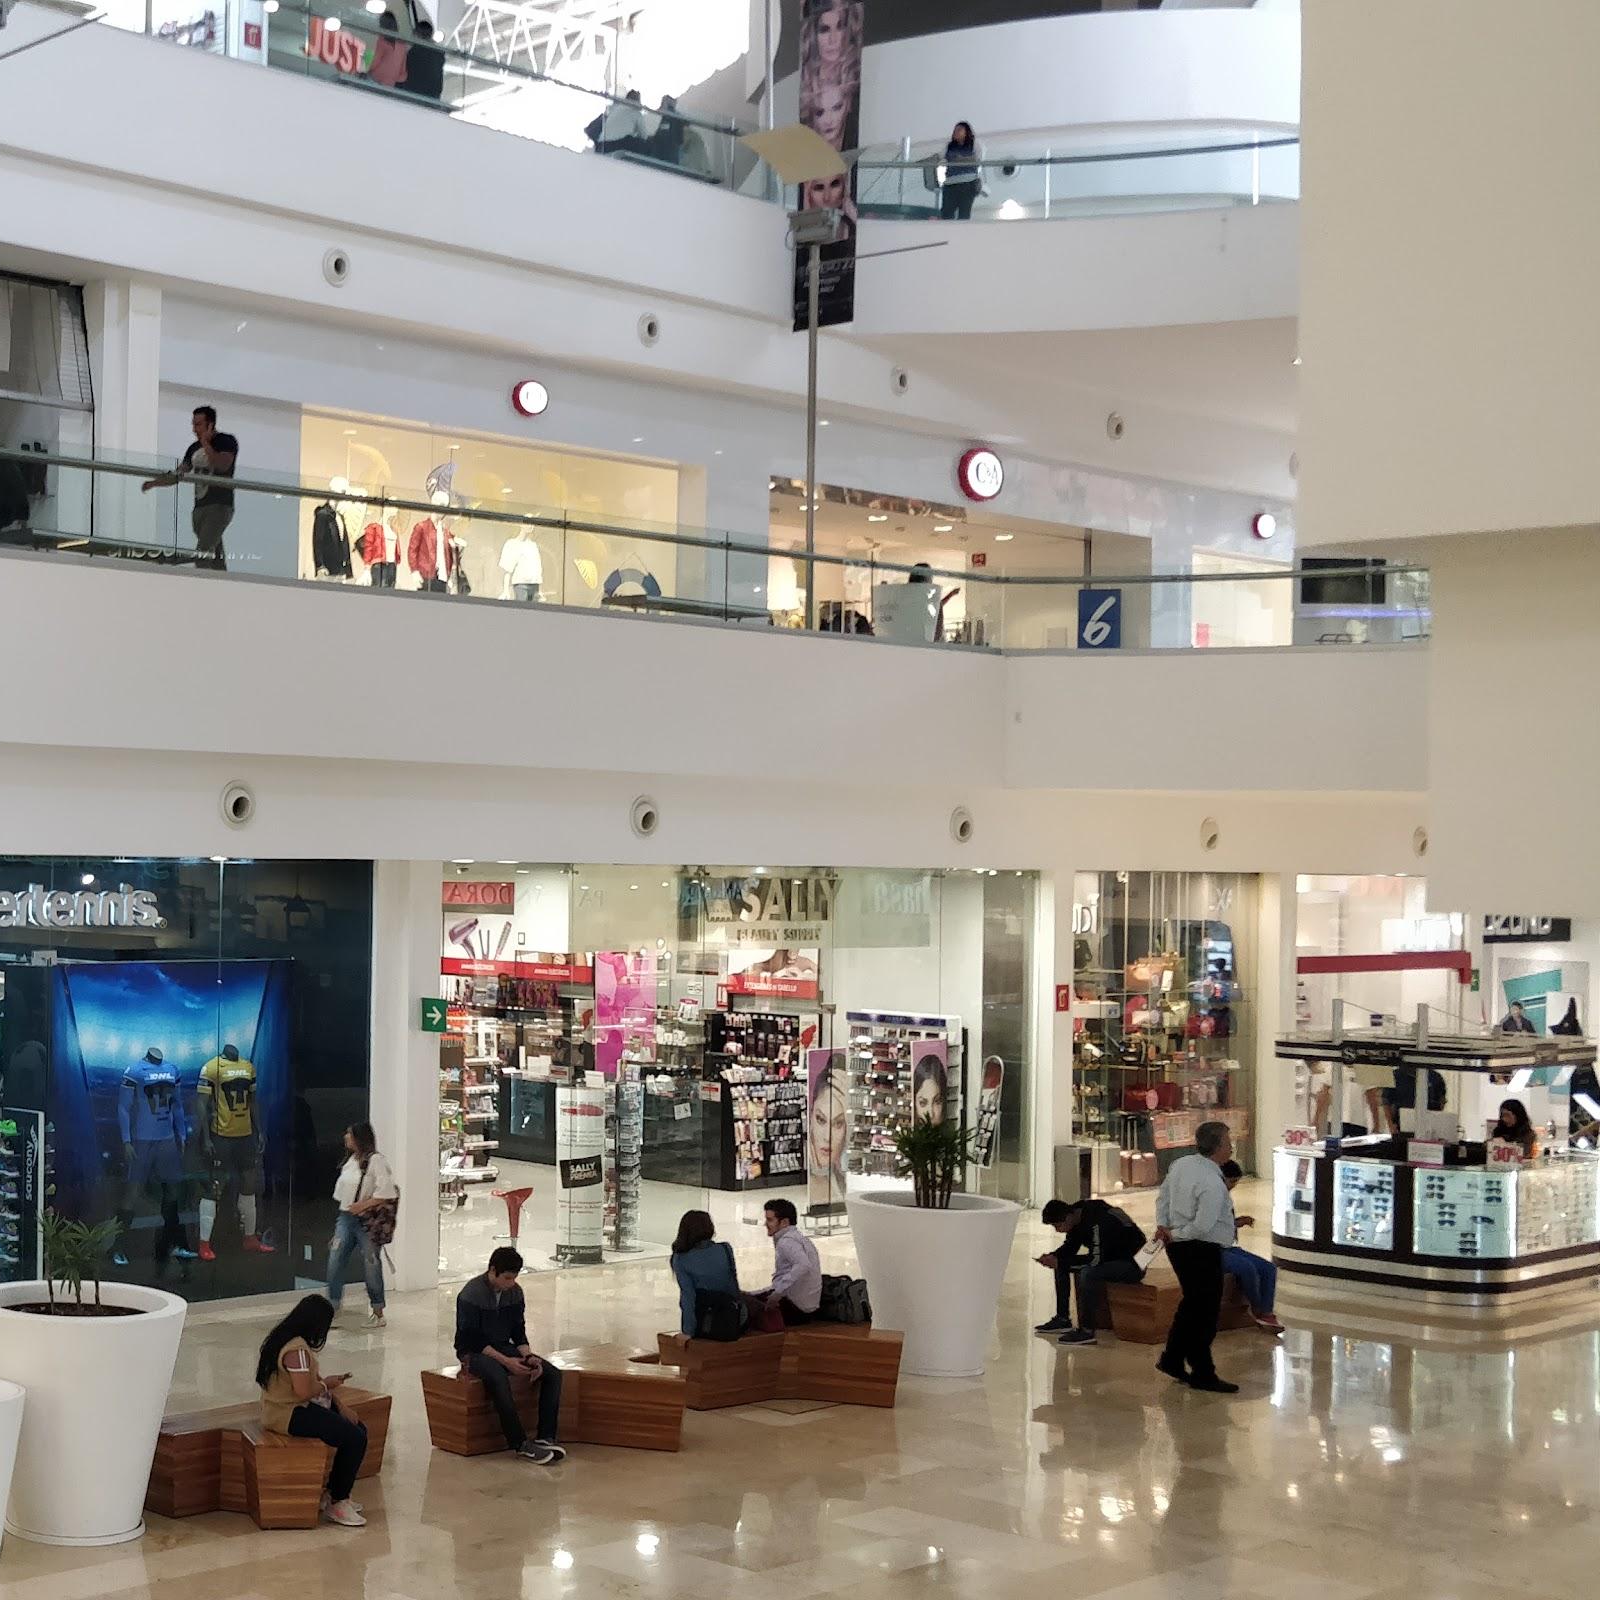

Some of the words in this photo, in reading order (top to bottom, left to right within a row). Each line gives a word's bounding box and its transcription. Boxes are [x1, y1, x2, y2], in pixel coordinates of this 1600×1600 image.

[1082, 595, 1116, 646] 6
[739, 877, 844, 922] SALLY
[25, 1140, 34, 1201] saucony
[569, 1161, 596, 1173] SALLY
